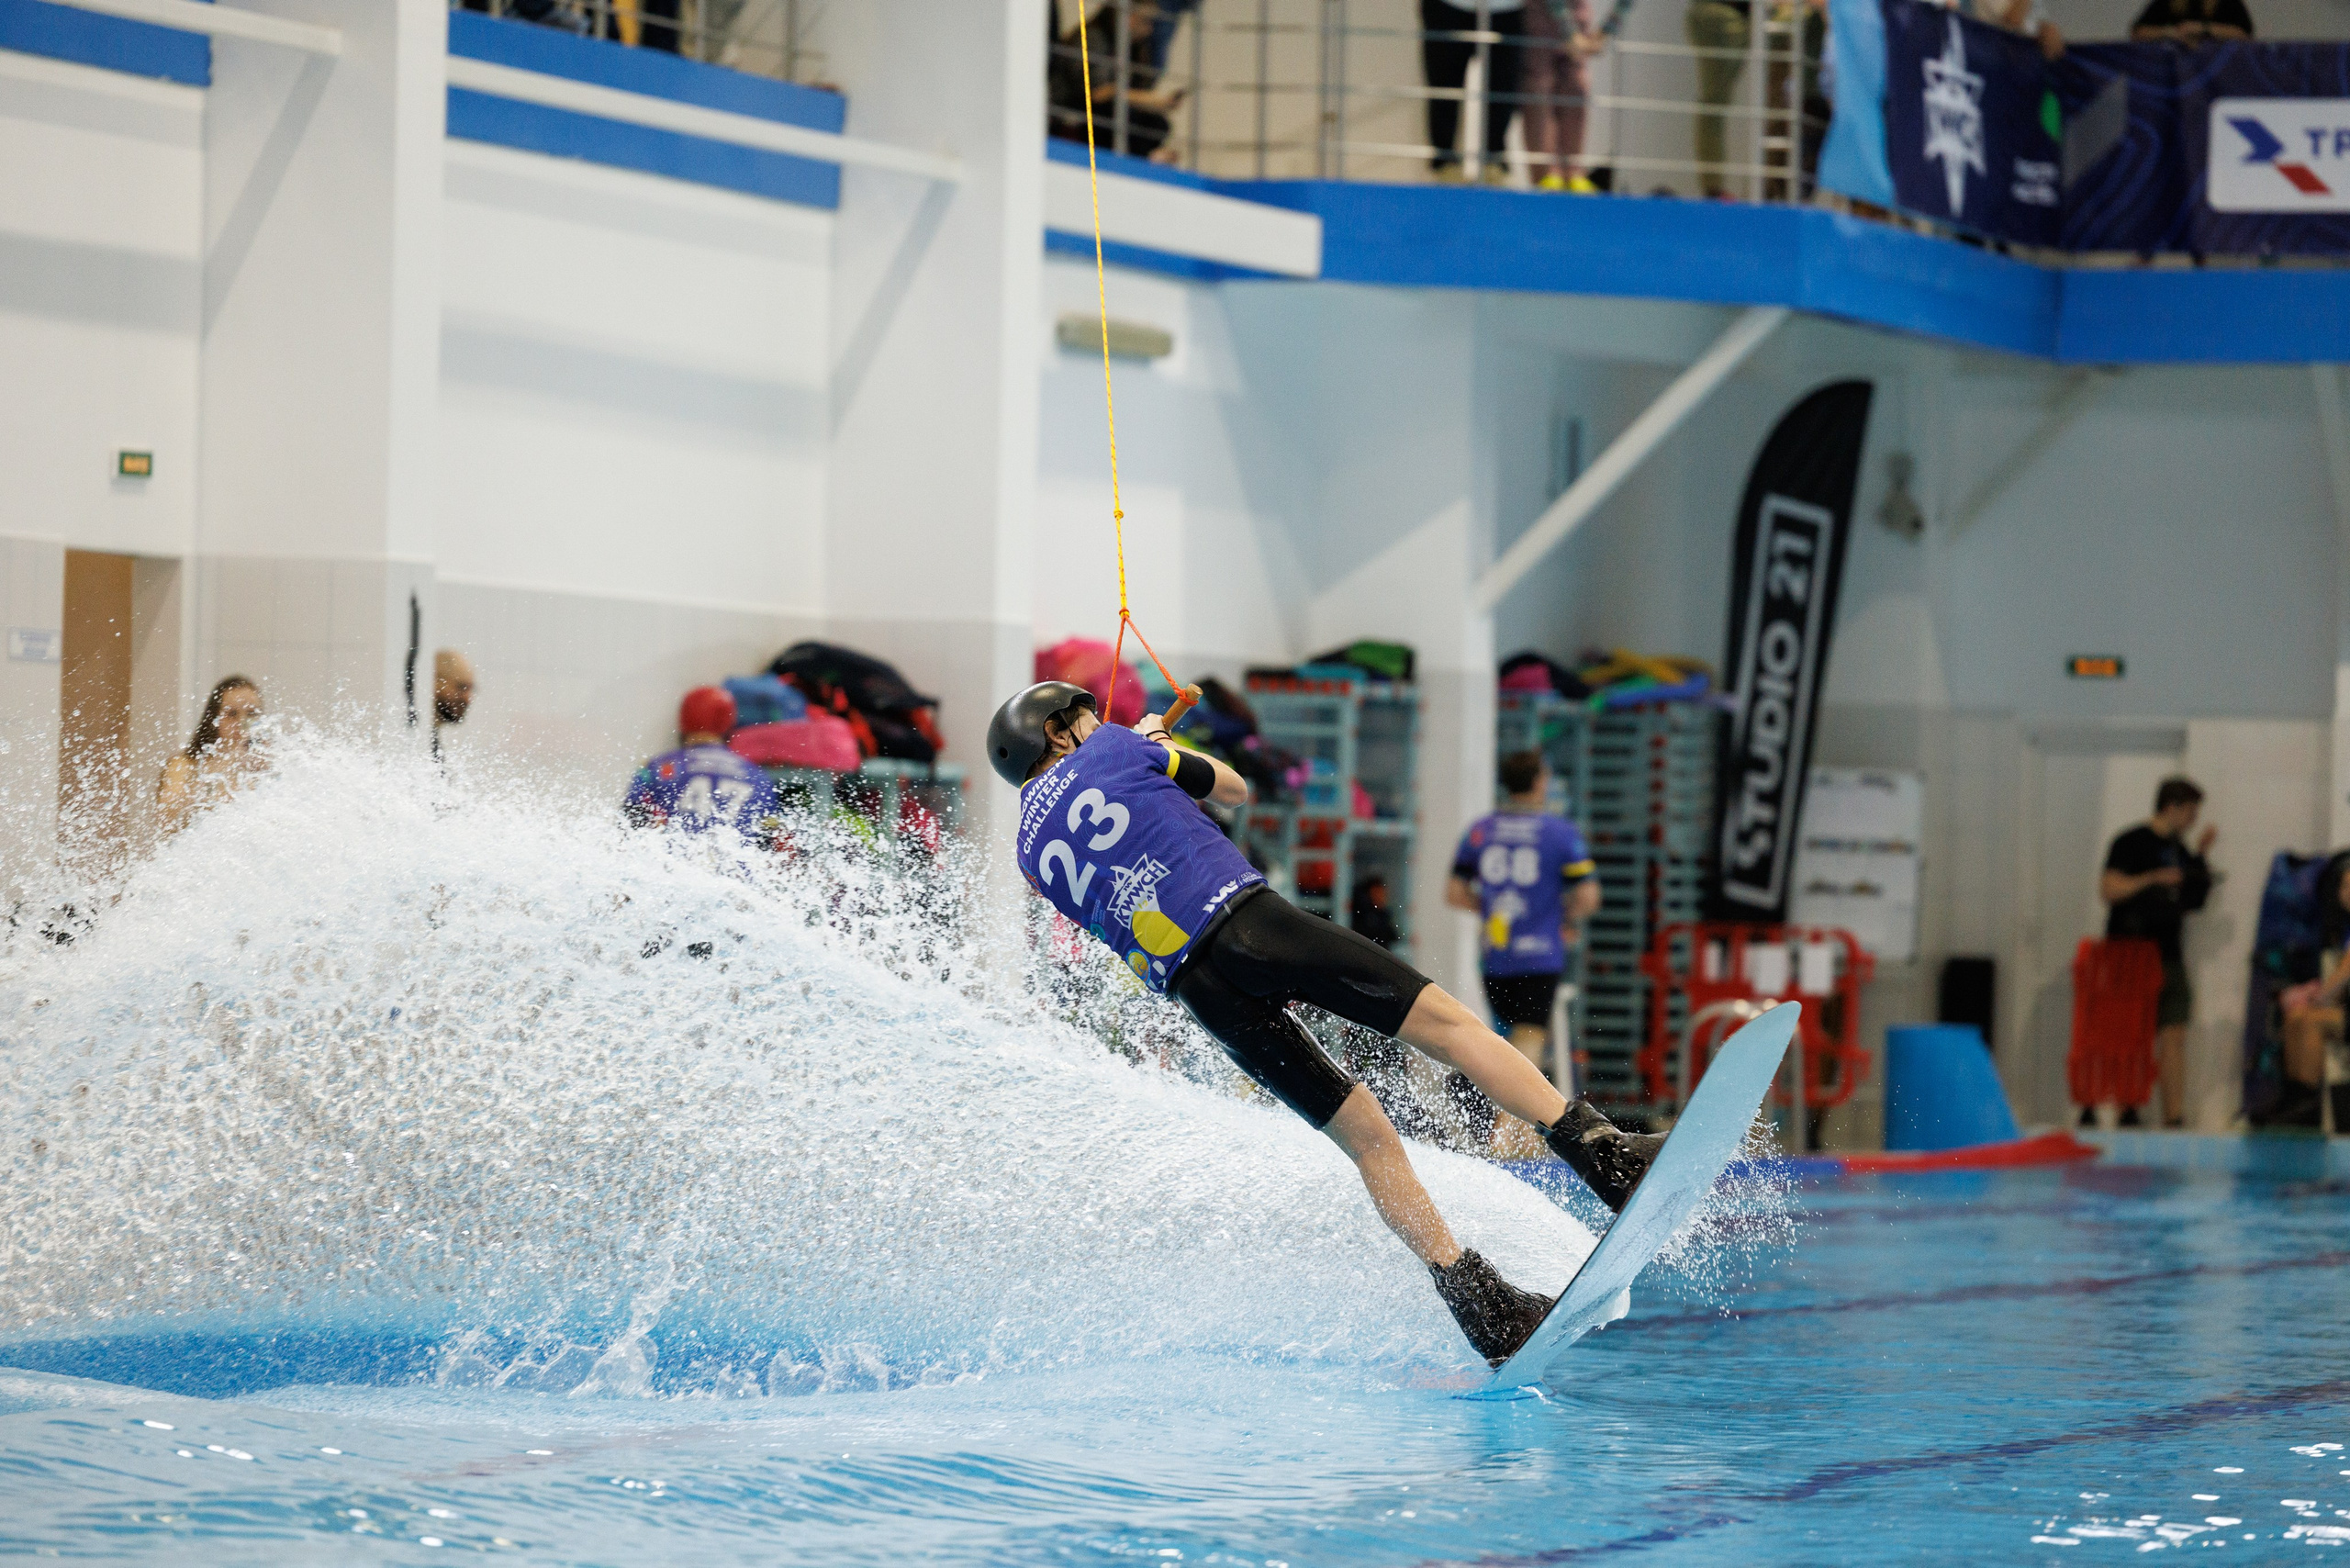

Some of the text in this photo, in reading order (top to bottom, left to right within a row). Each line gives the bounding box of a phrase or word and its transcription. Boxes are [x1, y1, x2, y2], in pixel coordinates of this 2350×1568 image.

[1736, 531, 1811, 868] STUDIO 21
[678, 775, 754, 826] 47
[1022, 775, 1059, 832] WINTER
[1024, 768, 1079, 855] CHALLENGE
[1039, 788, 1131, 907] 23
[1116, 862, 1167, 926] KWWCH
